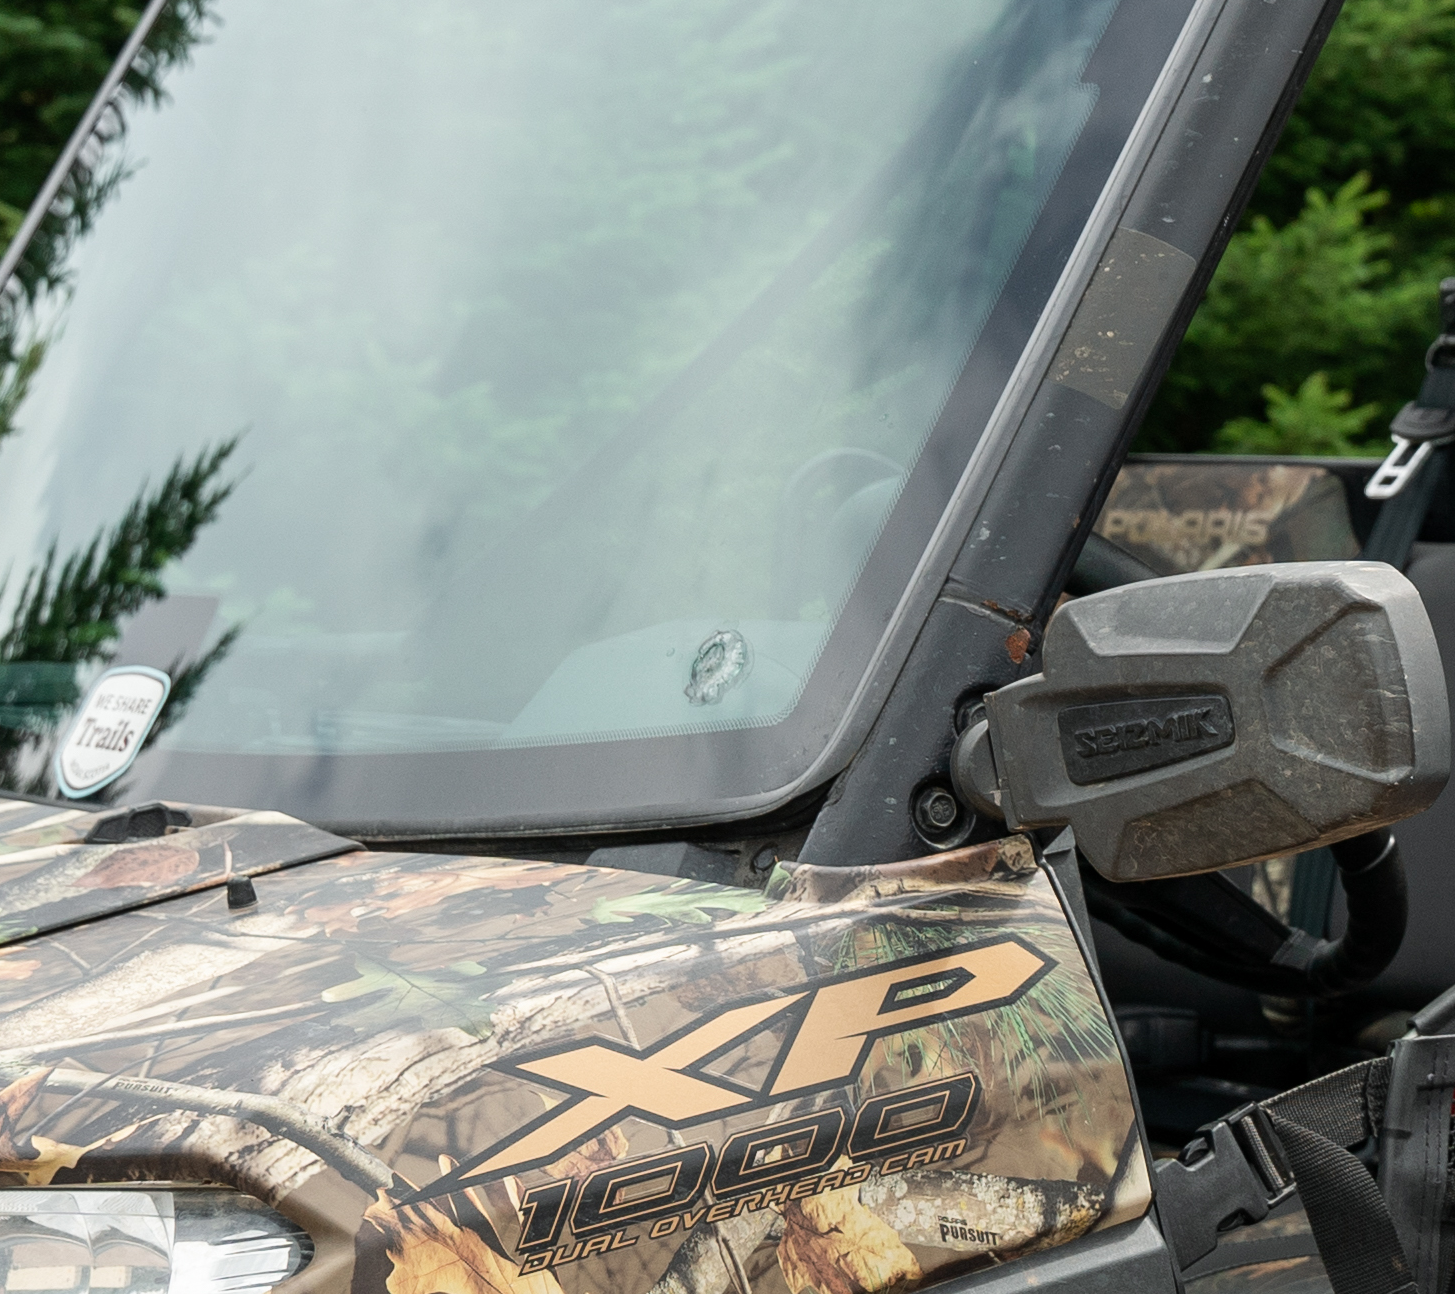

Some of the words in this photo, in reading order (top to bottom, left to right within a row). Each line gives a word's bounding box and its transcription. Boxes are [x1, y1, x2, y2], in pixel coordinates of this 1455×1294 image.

[95, 693, 116, 712] WE
[115, 693, 153, 716] SHARE
[76, 717, 135, 753] Trails
[1074, 707, 1220, 759] SEIZMIK
[420, 937, 1054, 1197] XP
[517, 1070, 983, 1254] 1000
[518, 1234, 641, 1277] DUAL
[649, 1162, 875, 1243] OVERHEAD
[879, 1136, 969, 1176] CAM
[939, 1223, 1001, 1246] PURSUIT
